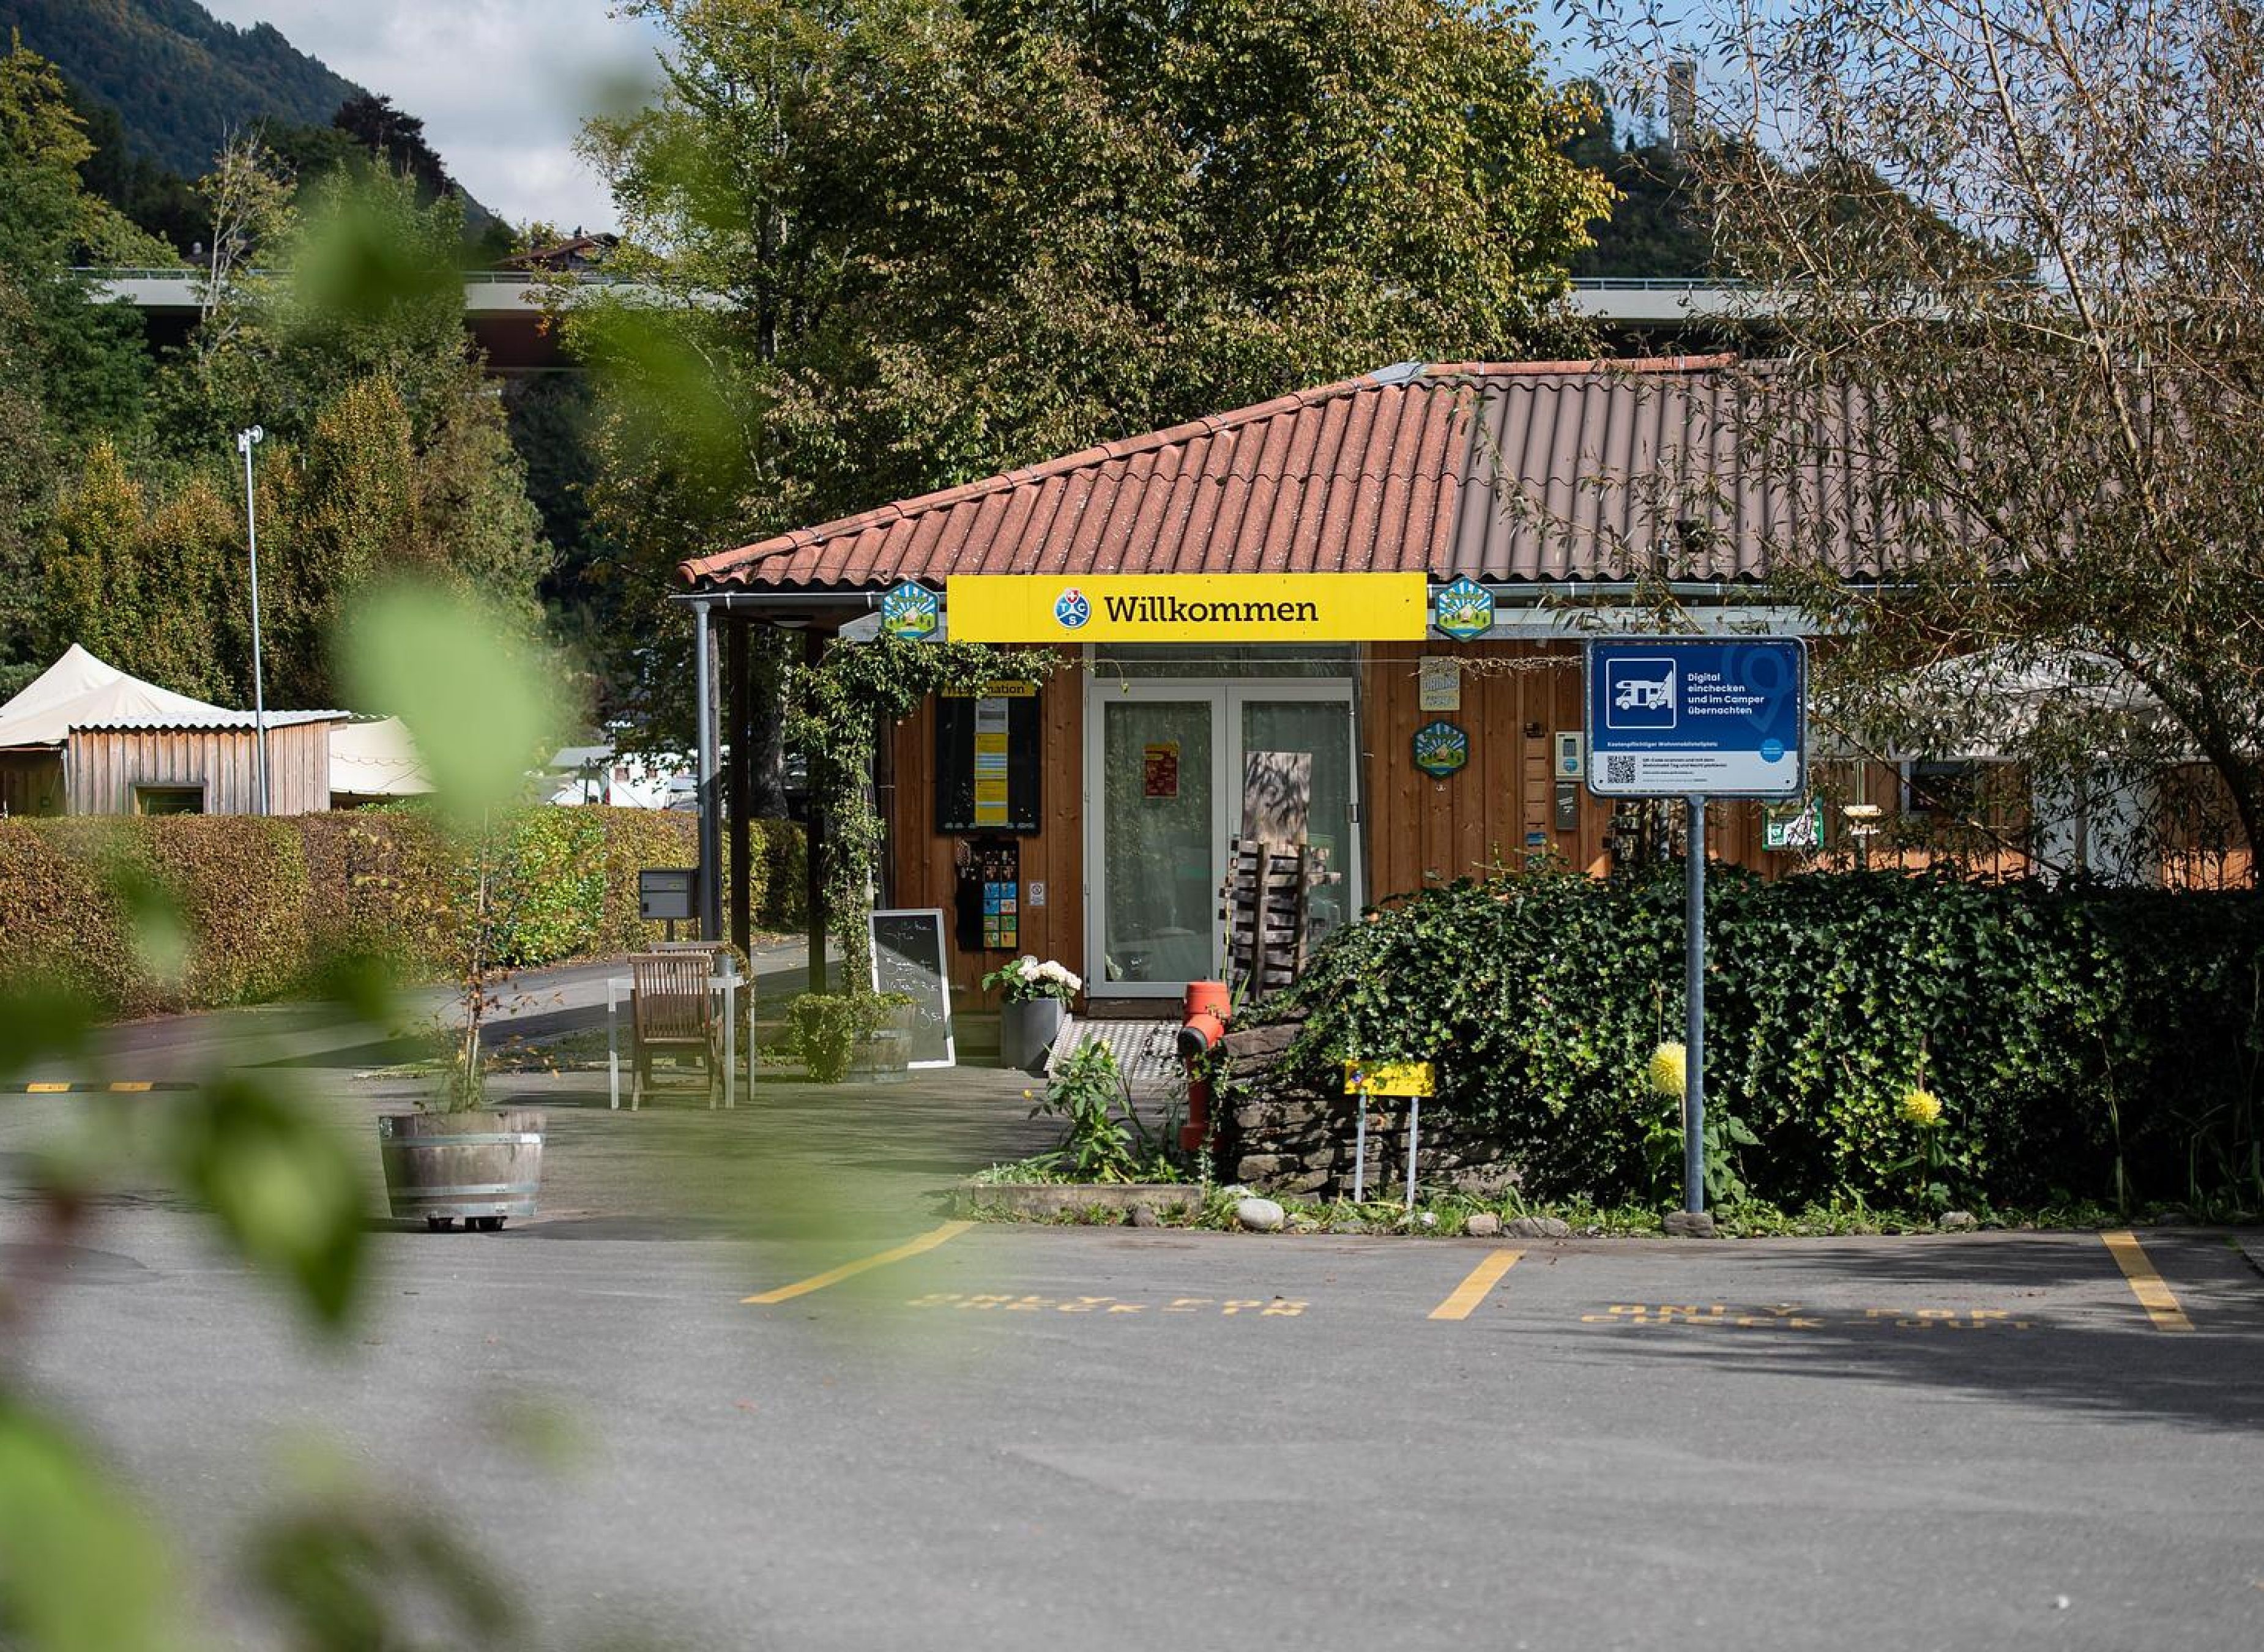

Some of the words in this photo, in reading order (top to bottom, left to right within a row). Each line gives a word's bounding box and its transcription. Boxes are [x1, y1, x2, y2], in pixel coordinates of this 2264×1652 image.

[1104, 595, 1319, 623] Willkommen
[1688, 672, 1721, 684] Digital
[1688, 683, 1746, 692] einchecken
[1688, 695, 1708, 704] und
[1708, 694, 1722, 704] im
[1723, 695, 1765, 705] Camper
[1688, 705, 1752, 715] übernachten
[1607, 1305, 1805, 1315] ONLY
[1864, 1309, 2010, 1319] FOR
